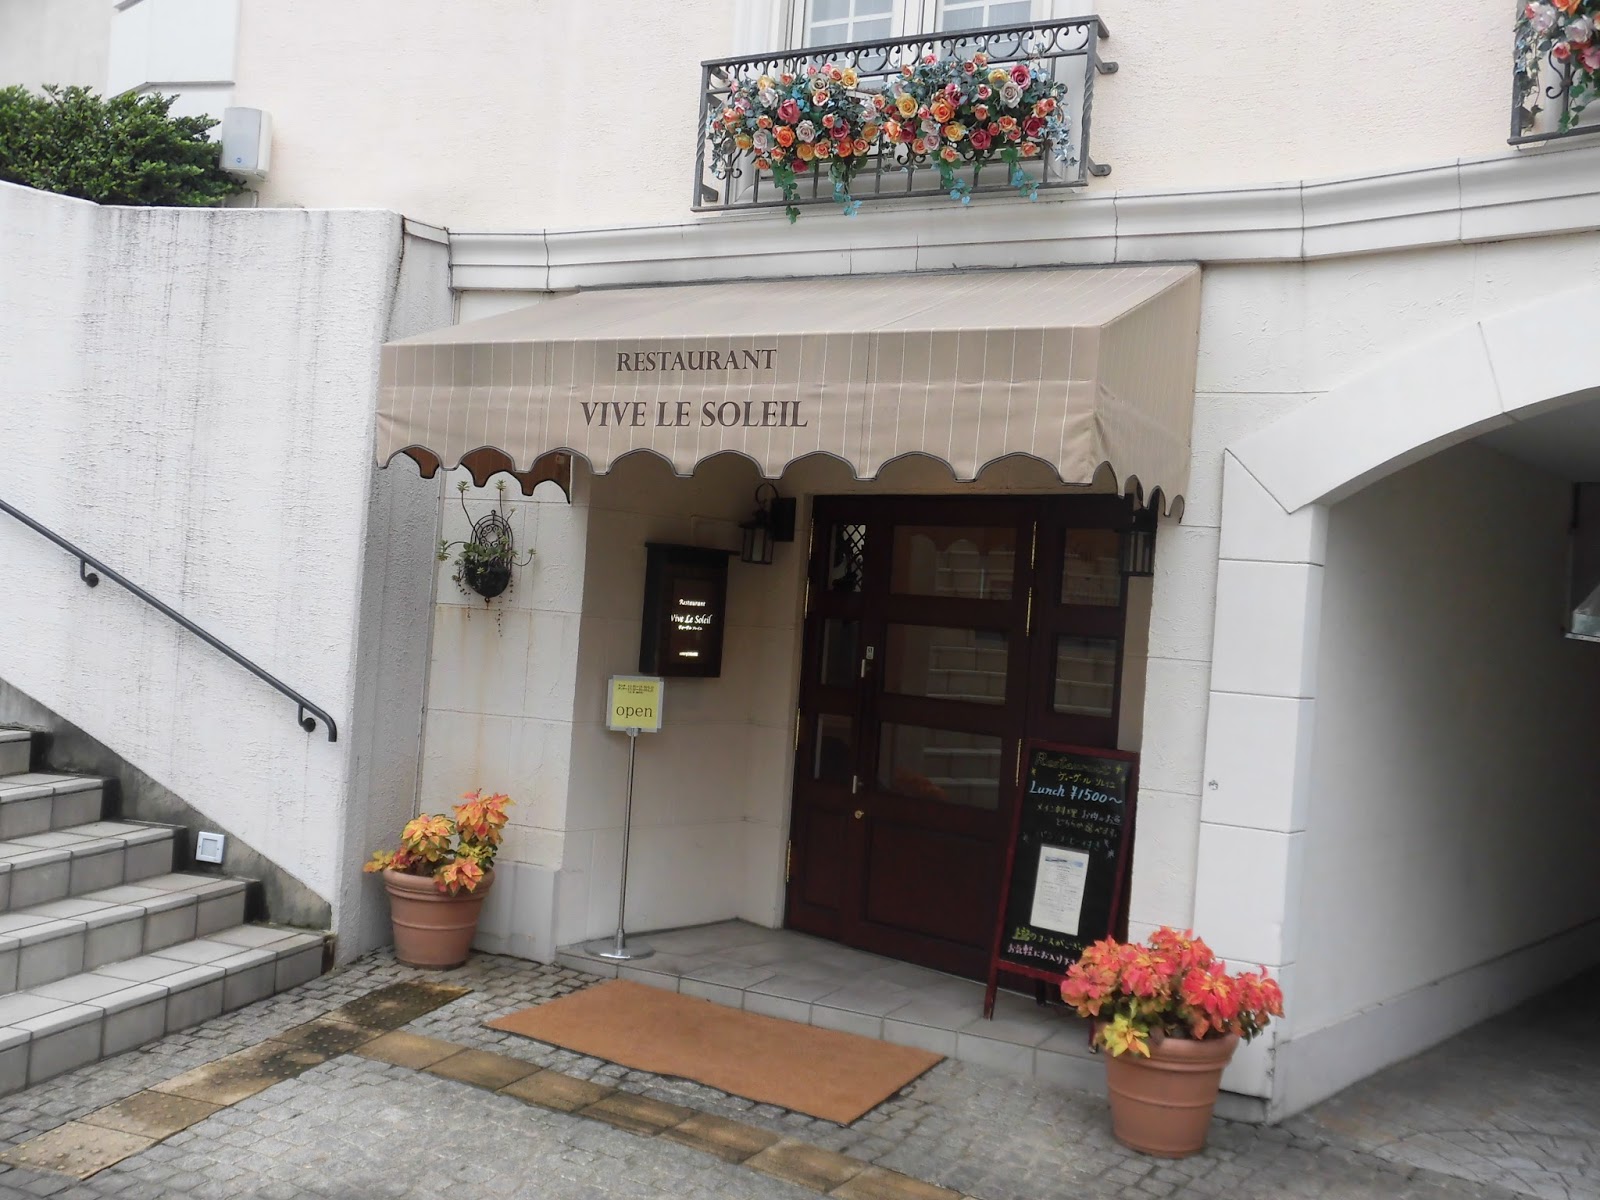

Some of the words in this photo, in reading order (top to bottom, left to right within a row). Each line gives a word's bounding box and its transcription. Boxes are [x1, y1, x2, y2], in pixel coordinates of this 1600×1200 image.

[616, 349, 777, 372] RESTAURANT
[580, 401, 647, 428] VIVE
[655, 401, 691, 427] LE
[700, 400, 809, 428] SOLEIL
[670, 613, 684, 624] Vive
[684, 614, 694, 624] Le
[694, 613, 713, 625] Soleil
[616, 705, 653, 719] open
[1029, 780, 1065, 797] Lunch
